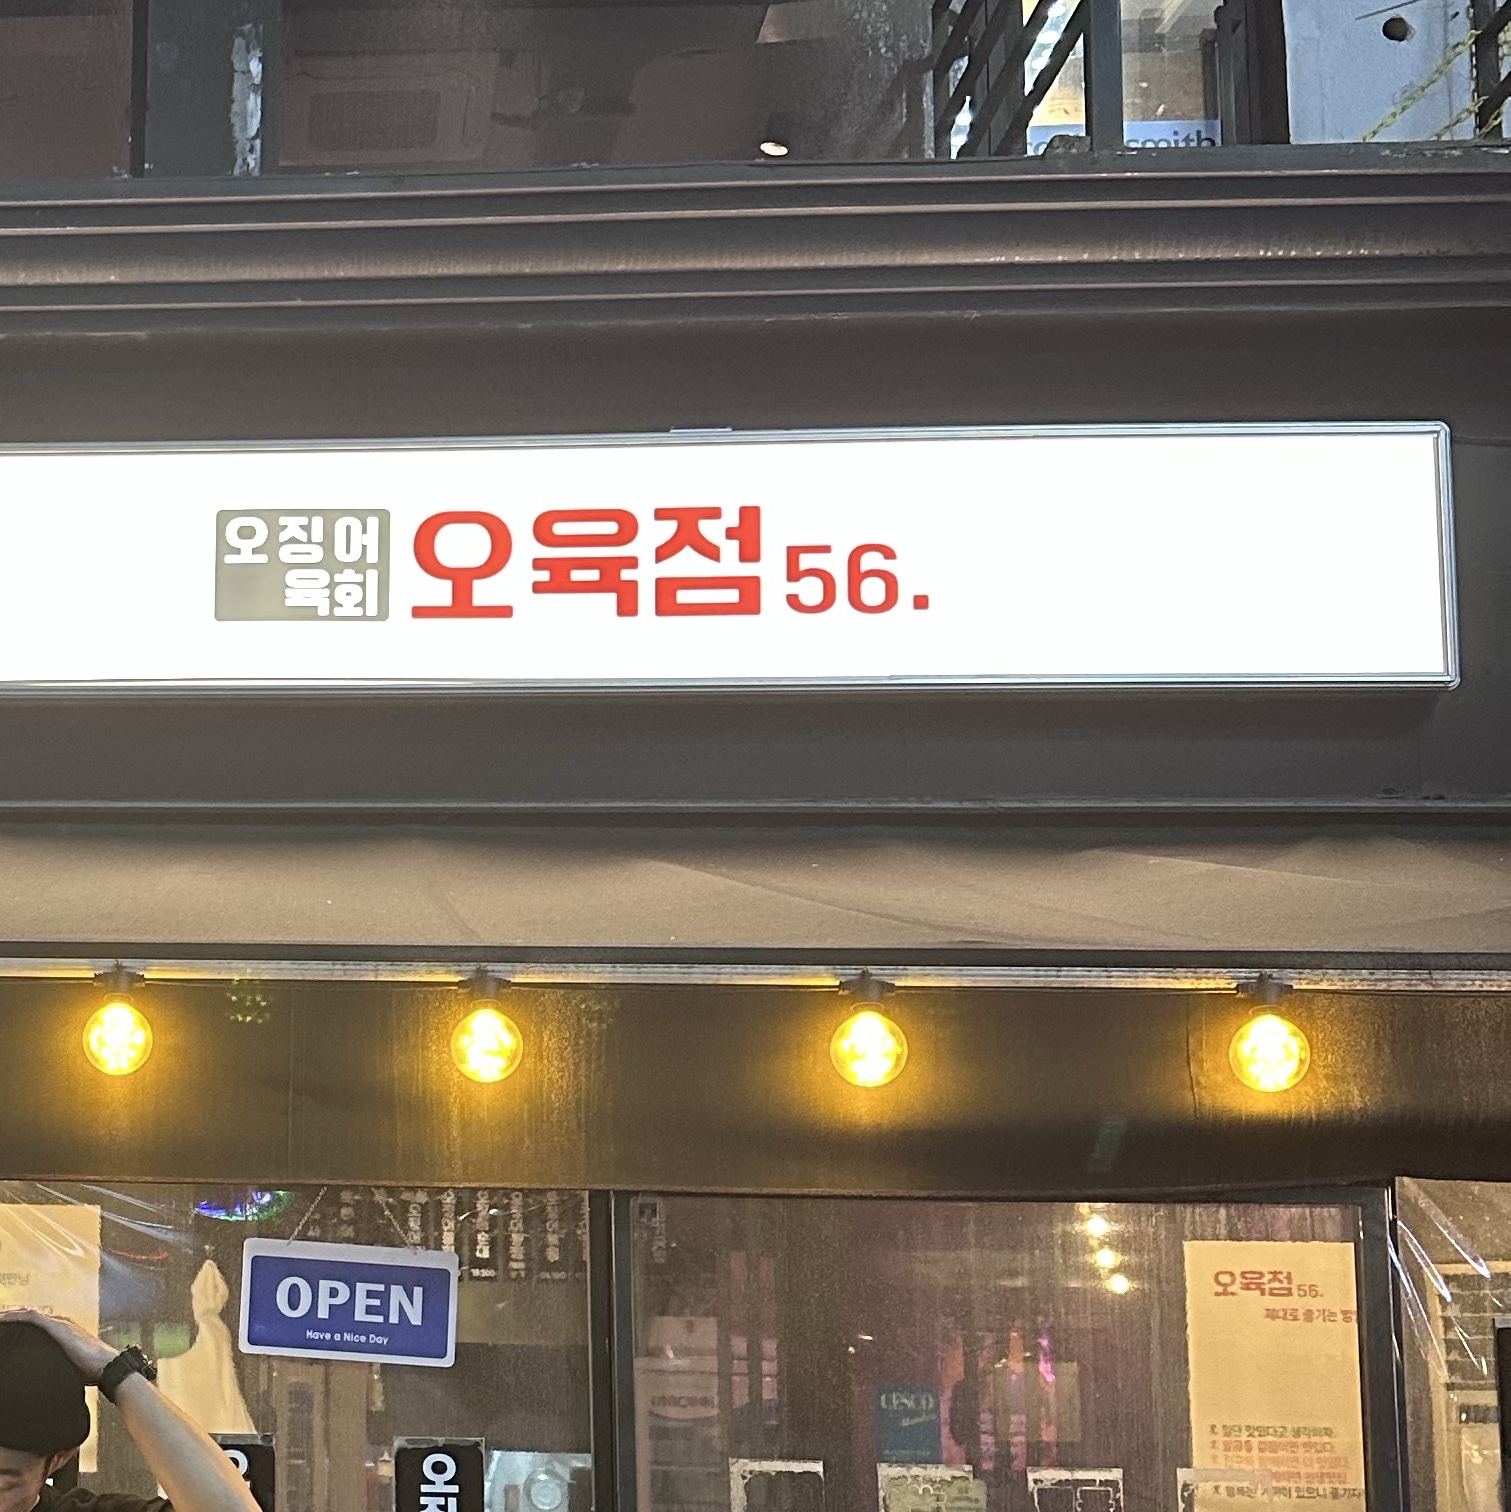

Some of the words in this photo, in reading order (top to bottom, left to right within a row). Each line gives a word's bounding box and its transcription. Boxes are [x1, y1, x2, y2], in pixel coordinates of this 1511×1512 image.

[223, 515, 380, 565] 오징어
[412, 505, 761, 619] 오육점
[284, 567, 379, 617] 육회
[276, 1276, 423, 1326] OPEN
[1213, 1270, 1294, 1297] 오육점
[306, 1330, 331, 1340] Have
[344, 1332, 366, 1343] Nice
[369, 1334, 388, 1345] Day
